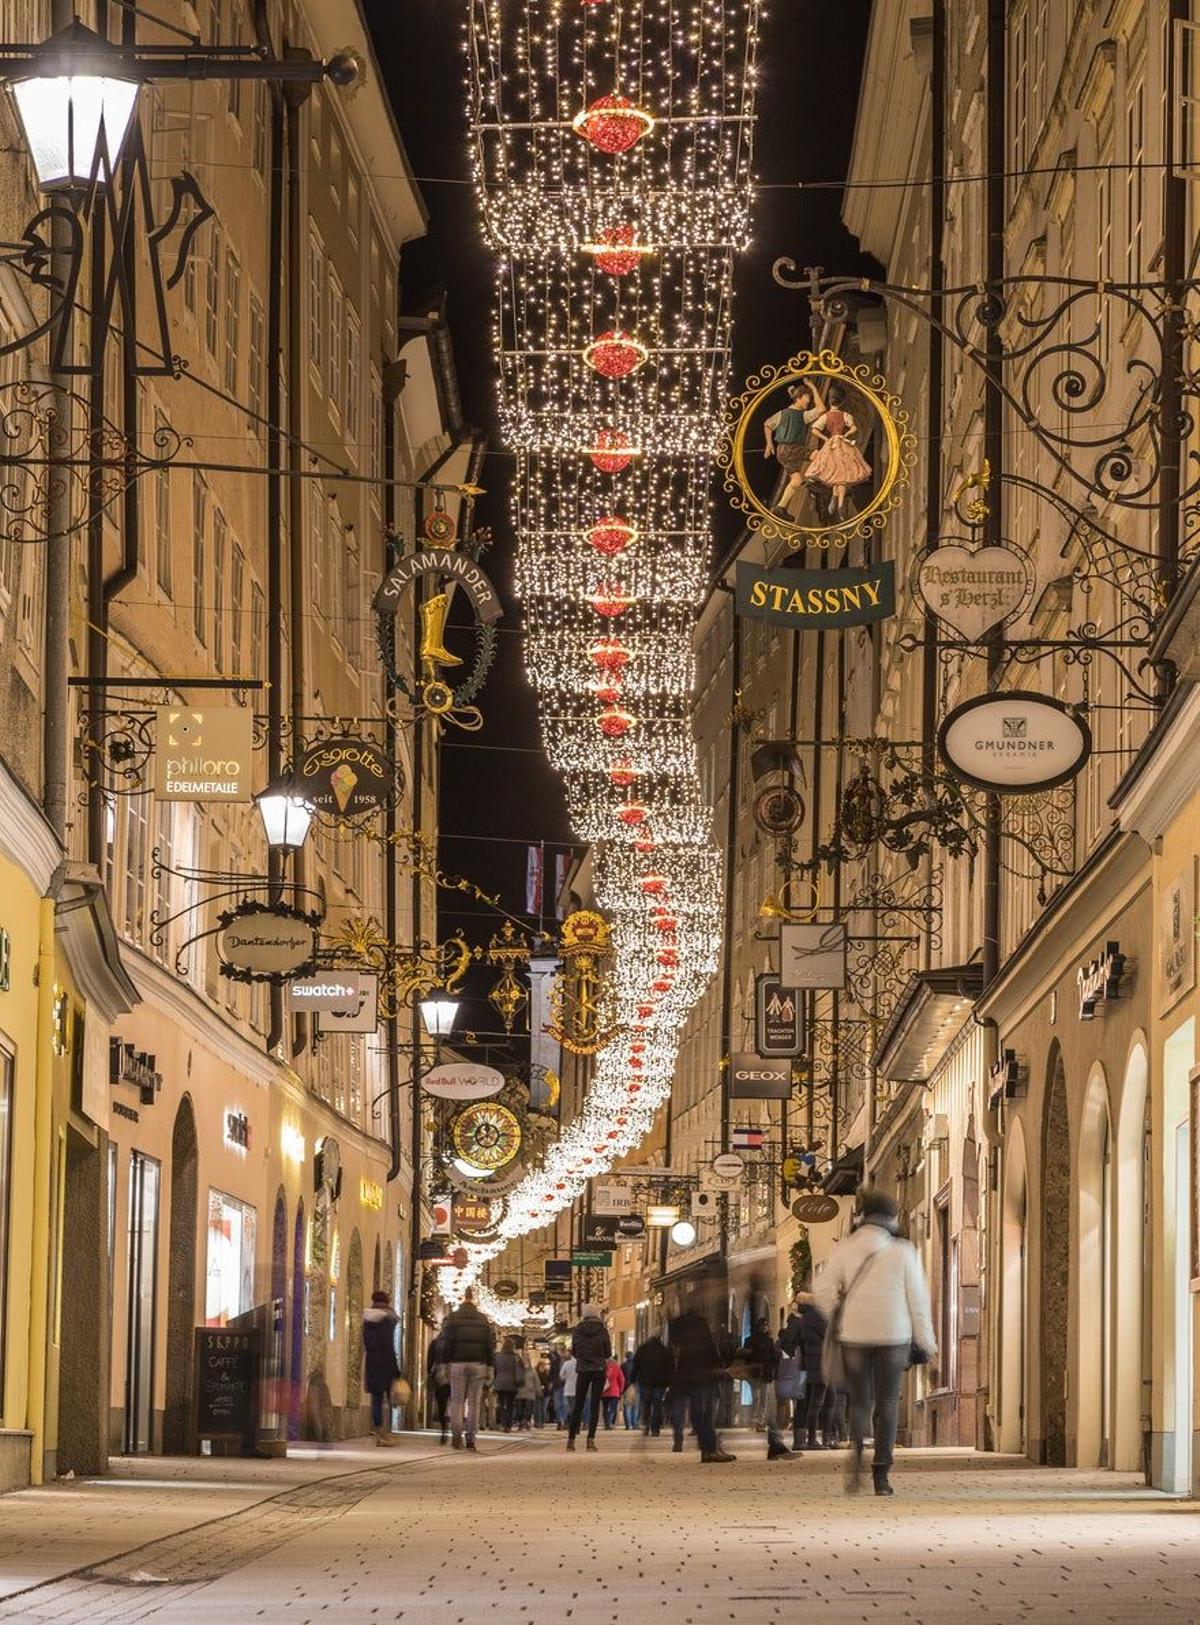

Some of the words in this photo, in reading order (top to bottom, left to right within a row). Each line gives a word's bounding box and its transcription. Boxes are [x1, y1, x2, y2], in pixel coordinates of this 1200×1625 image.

[383, 552, 493, 605] SALAMANDER
[922, 564, 1024, 587] Restaurant
[749, 579, 881, 614] STASSNY
[974, 740, 1056, 751] GMUNDNER
[166, 756, 241, 780] philoro
[166, 780, 239, 794] EDELMETALLE
[312, 794, 334, 804] seit
[354, 794, 377, 804] 1958
[292, 984, 346, 997] swatch
[735, 1070, 788, 1081] GEOX
